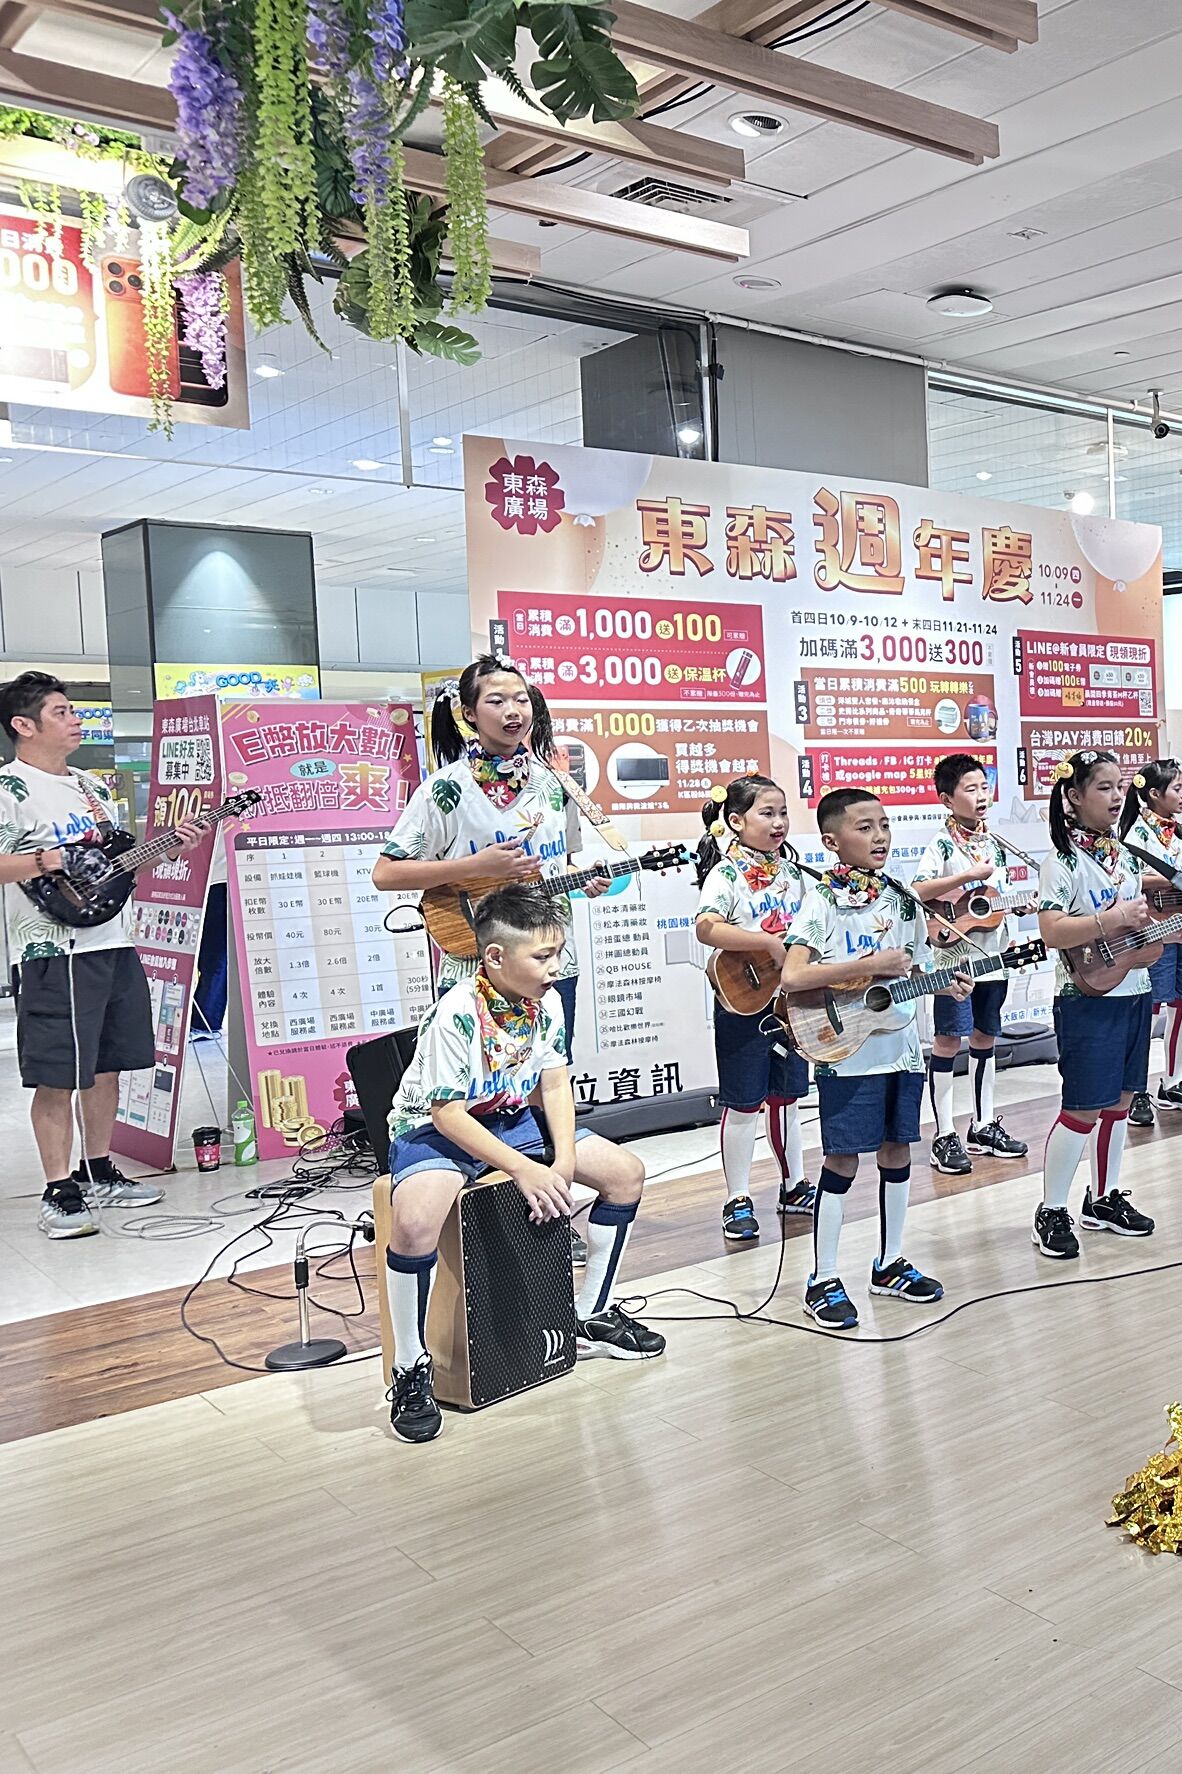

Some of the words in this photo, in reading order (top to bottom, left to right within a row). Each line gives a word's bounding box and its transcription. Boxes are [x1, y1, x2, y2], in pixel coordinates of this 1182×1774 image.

[502, 473, 549, 496] 東森
[503, 497, 549, 521] 廣場
[636, 487, 1034, 605] 東森週年慶
[527, 608, 553, 623] 累積
[800, 634, 983, 666] 加碼滿3,000送300
[1026, 641, 1105, 659] LINE@新會員限定
[1109, 645, 1148, 661] 現領現折
[530, 657, 555, 671] 累積
[216, 671, 262, 688] GOOD
[162, 741, 195, 759] LINE好友
[230, 720, 405, 766] E幣放大數!
[675, 742, 717, 758] 買越多
[299, 760, 329, 776] 就是
[834, 755, 878, 766] Threads
[884, 756, 897, 766] FB
[903, 755, 915, 766] IG
[916, 755, 932, 765] 打卡
[165, 761, 190, 781] 募集中
[884, 771, 907, 781] map
[909, 768, 935, 779] 5星好
[356, 868, 371, 876] KTV
[602, 903, 647, 913] 松本清藥妝
[285, 929, 305, 939] 40元
[323, 927, 342, 936] 80元
[364, 924, 383, 933] 30元
[603, 918, 648, 929] 松本清藥妝
[253, 957, 271, 966] 放大
[289, 960, 310, 969] 1.3倍
[327, 957, 347, 966] 2.6倍
[367, 953, 381, 962] 2倍
[606, 965, 619, 975] QB
[621, 962, 652, 972] HOUSE
[607, 992, 643, 1003] 眼鏡市場
